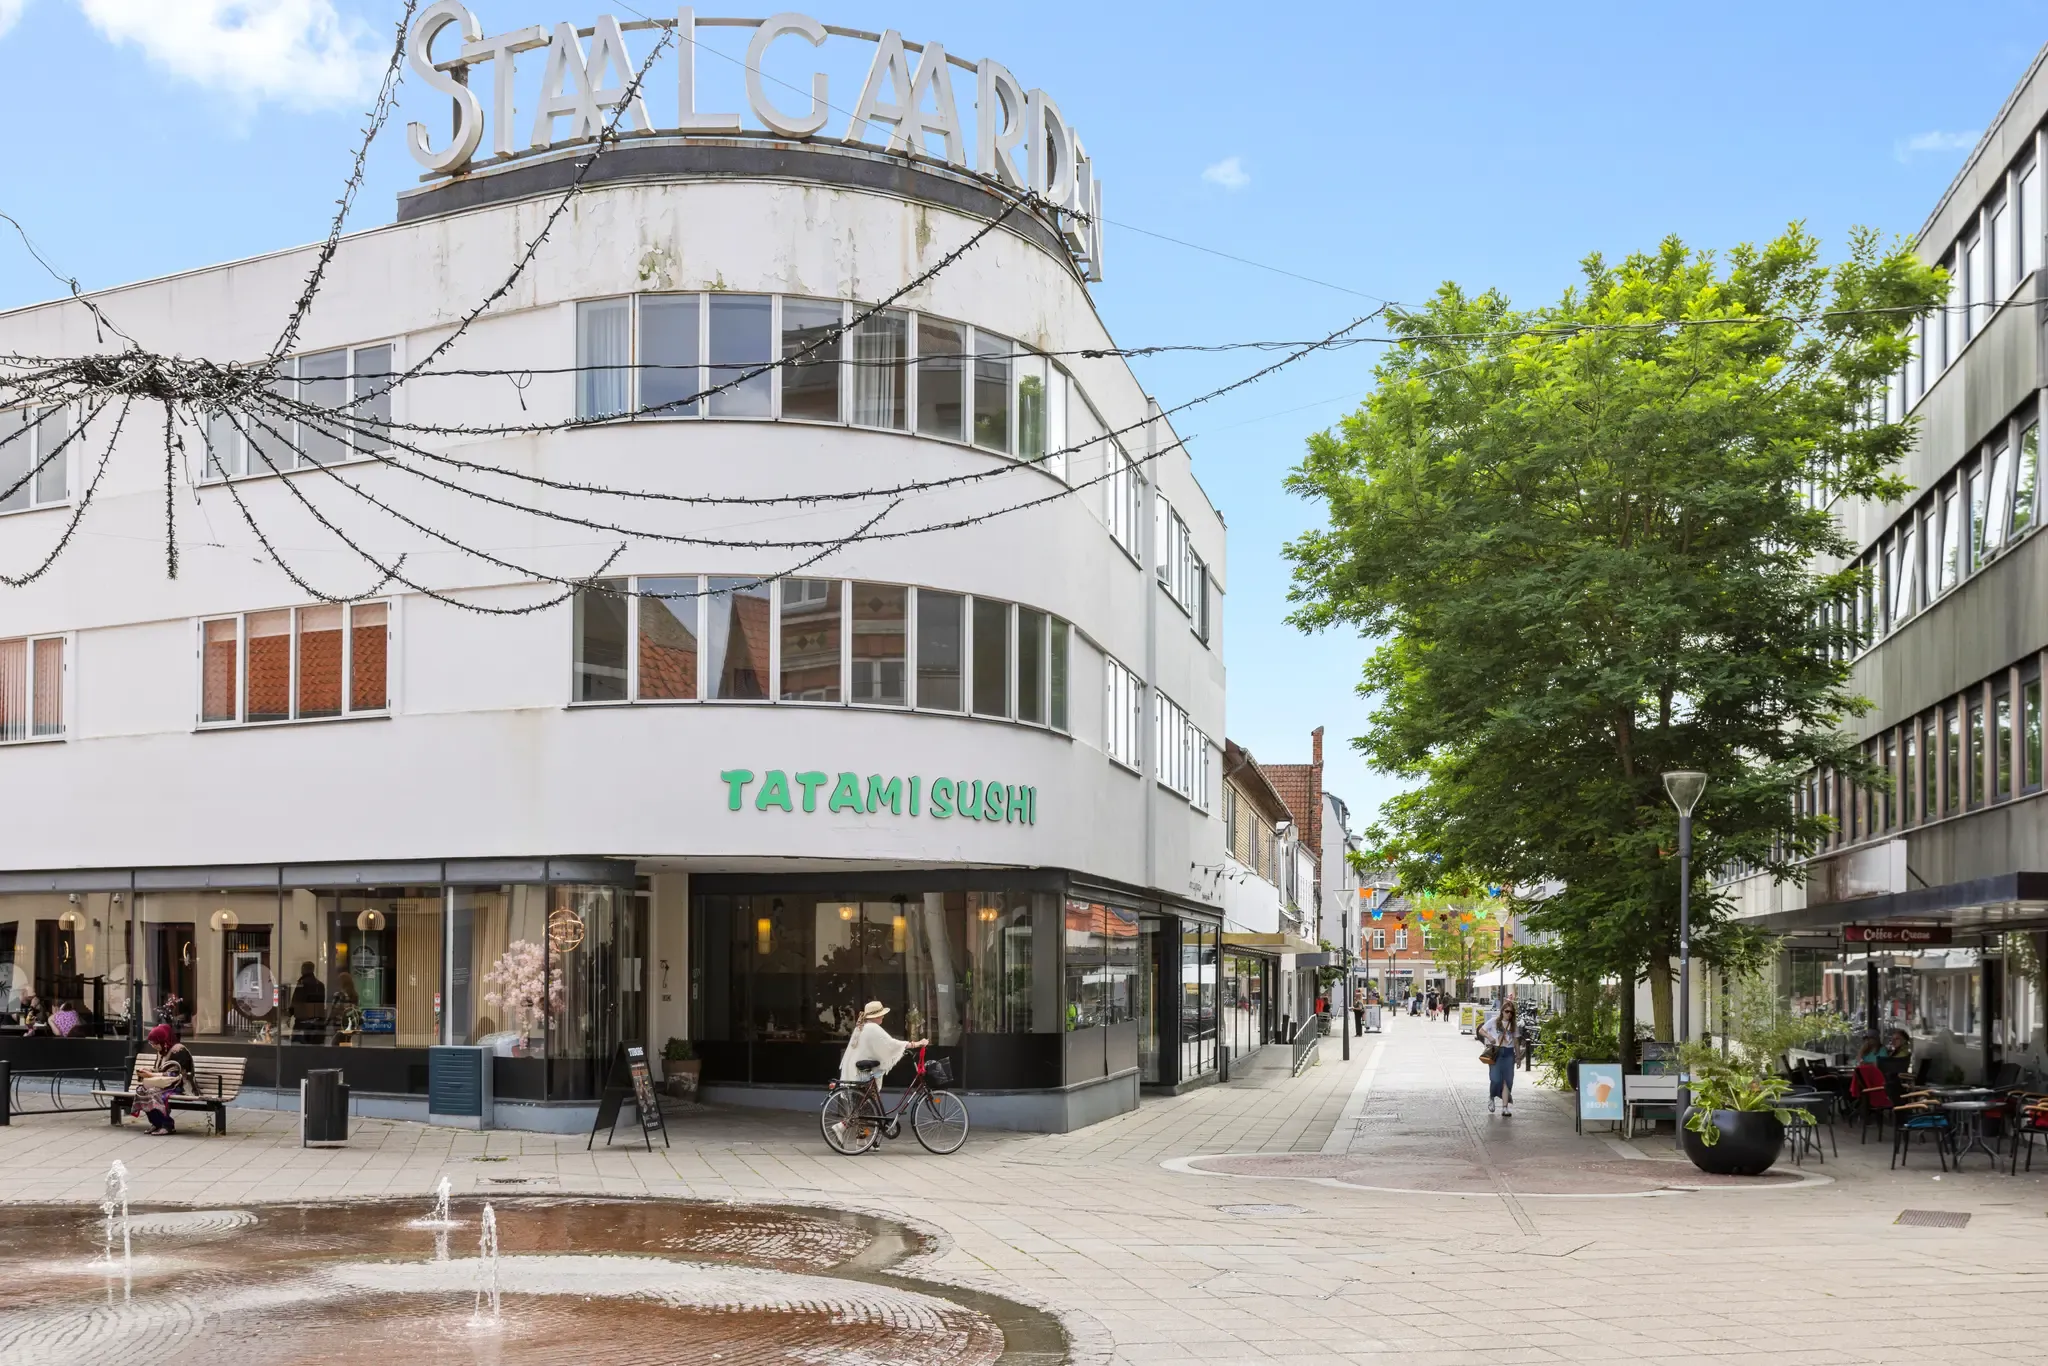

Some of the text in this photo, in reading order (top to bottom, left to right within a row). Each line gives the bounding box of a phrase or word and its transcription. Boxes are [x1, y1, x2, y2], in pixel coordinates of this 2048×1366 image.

[407, 0, 1103, 282] STAALGAARDEN
[720, 768, 1037, 826] TATAMI SUSHI
[1863, 928, 1893, 941] Coffee
